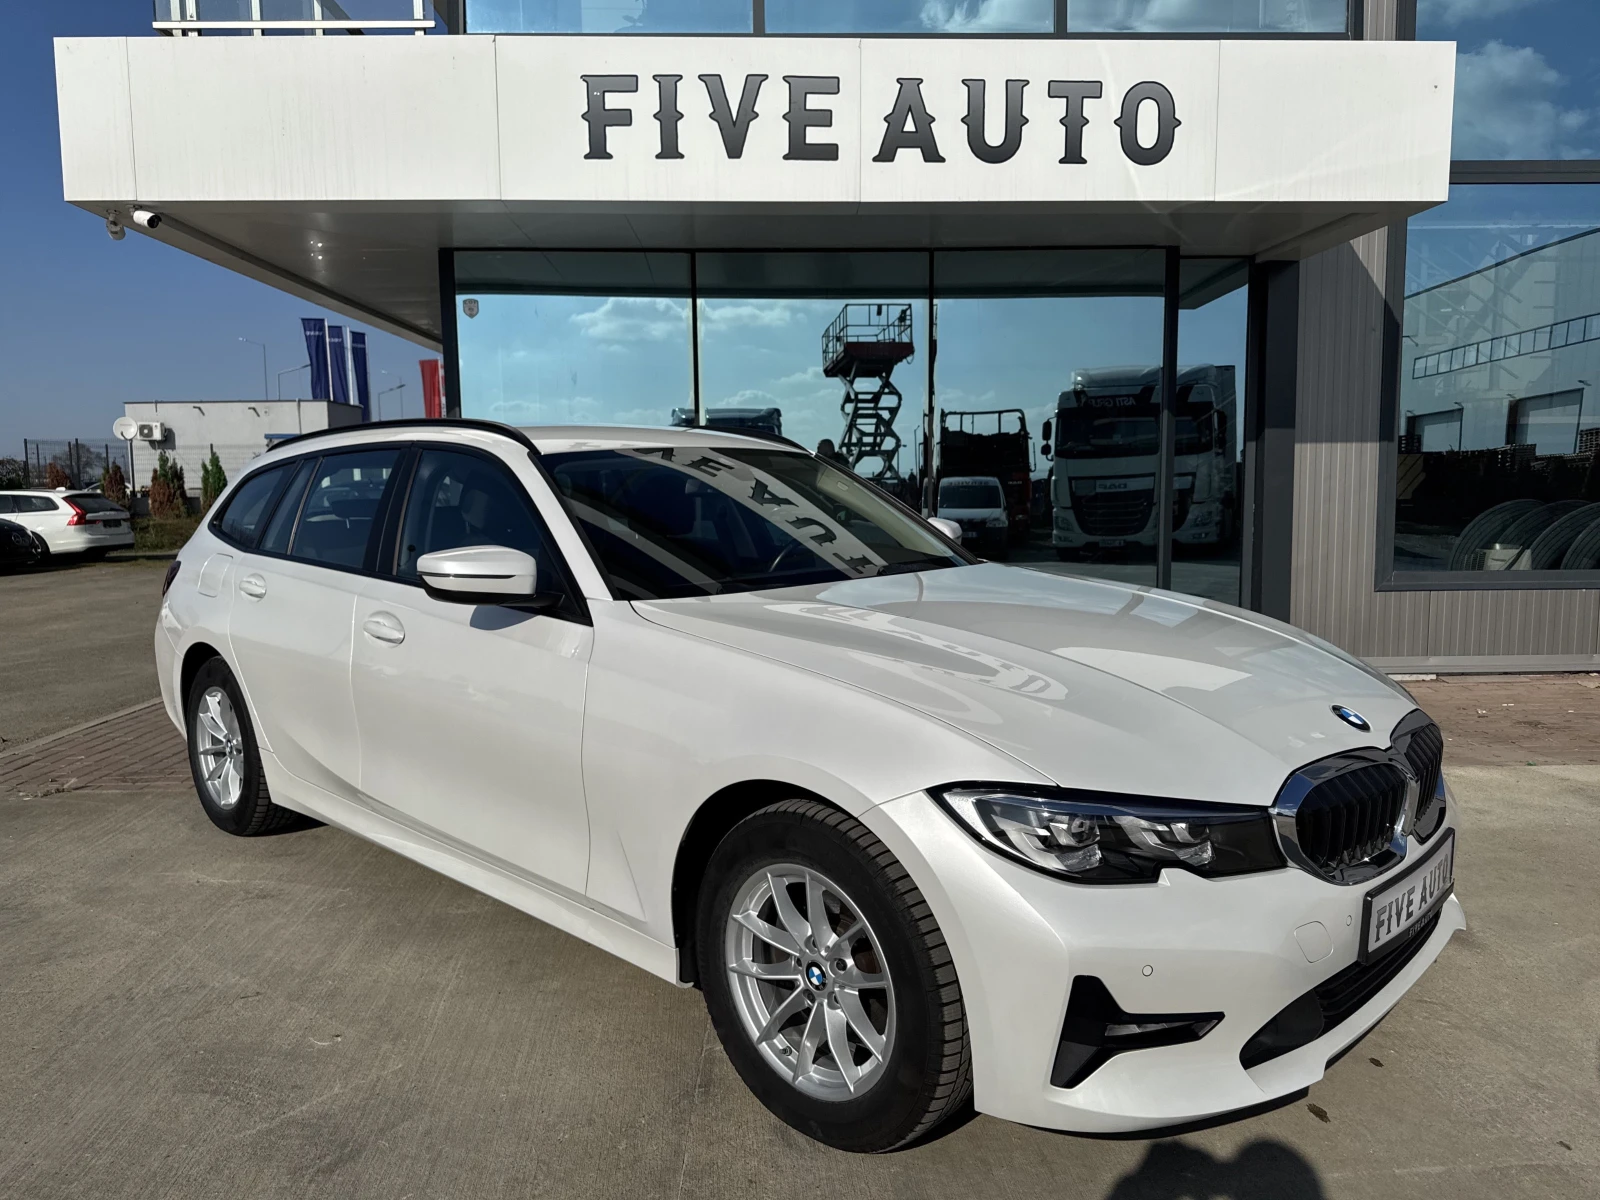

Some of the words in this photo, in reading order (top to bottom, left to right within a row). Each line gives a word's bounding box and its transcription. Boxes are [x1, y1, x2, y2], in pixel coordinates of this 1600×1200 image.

[580, 74, 840, 160] FIVE
[872, 77, 1182, 166] AUTO
[1374, 886, 1416, 943] FIVE
[1418, 853, 1449, 911] AUTO
